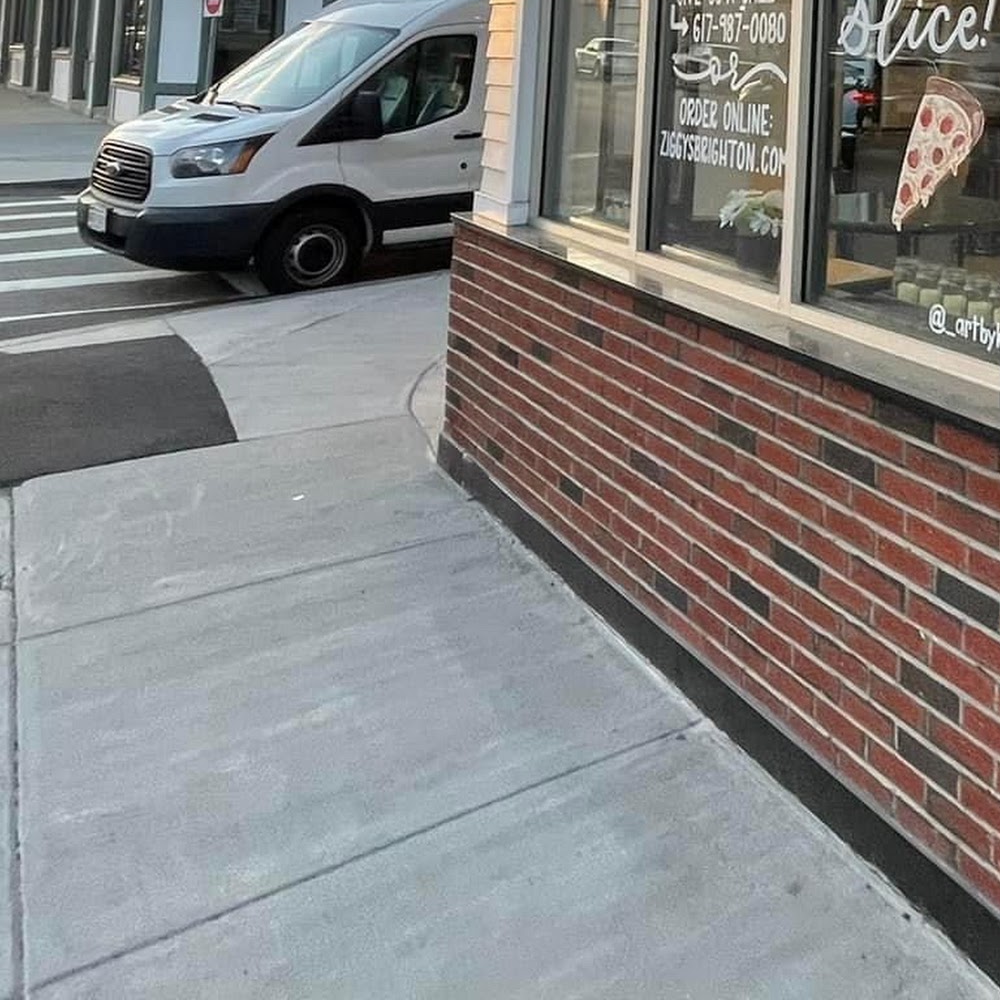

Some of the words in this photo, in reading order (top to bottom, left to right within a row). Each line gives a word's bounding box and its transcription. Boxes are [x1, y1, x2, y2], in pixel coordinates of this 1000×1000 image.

[692, 12, 786, 44] 617-987-0080
[679, 97, 718, 129] ORDER
[723, 101, 774, 137] ONLINE:
